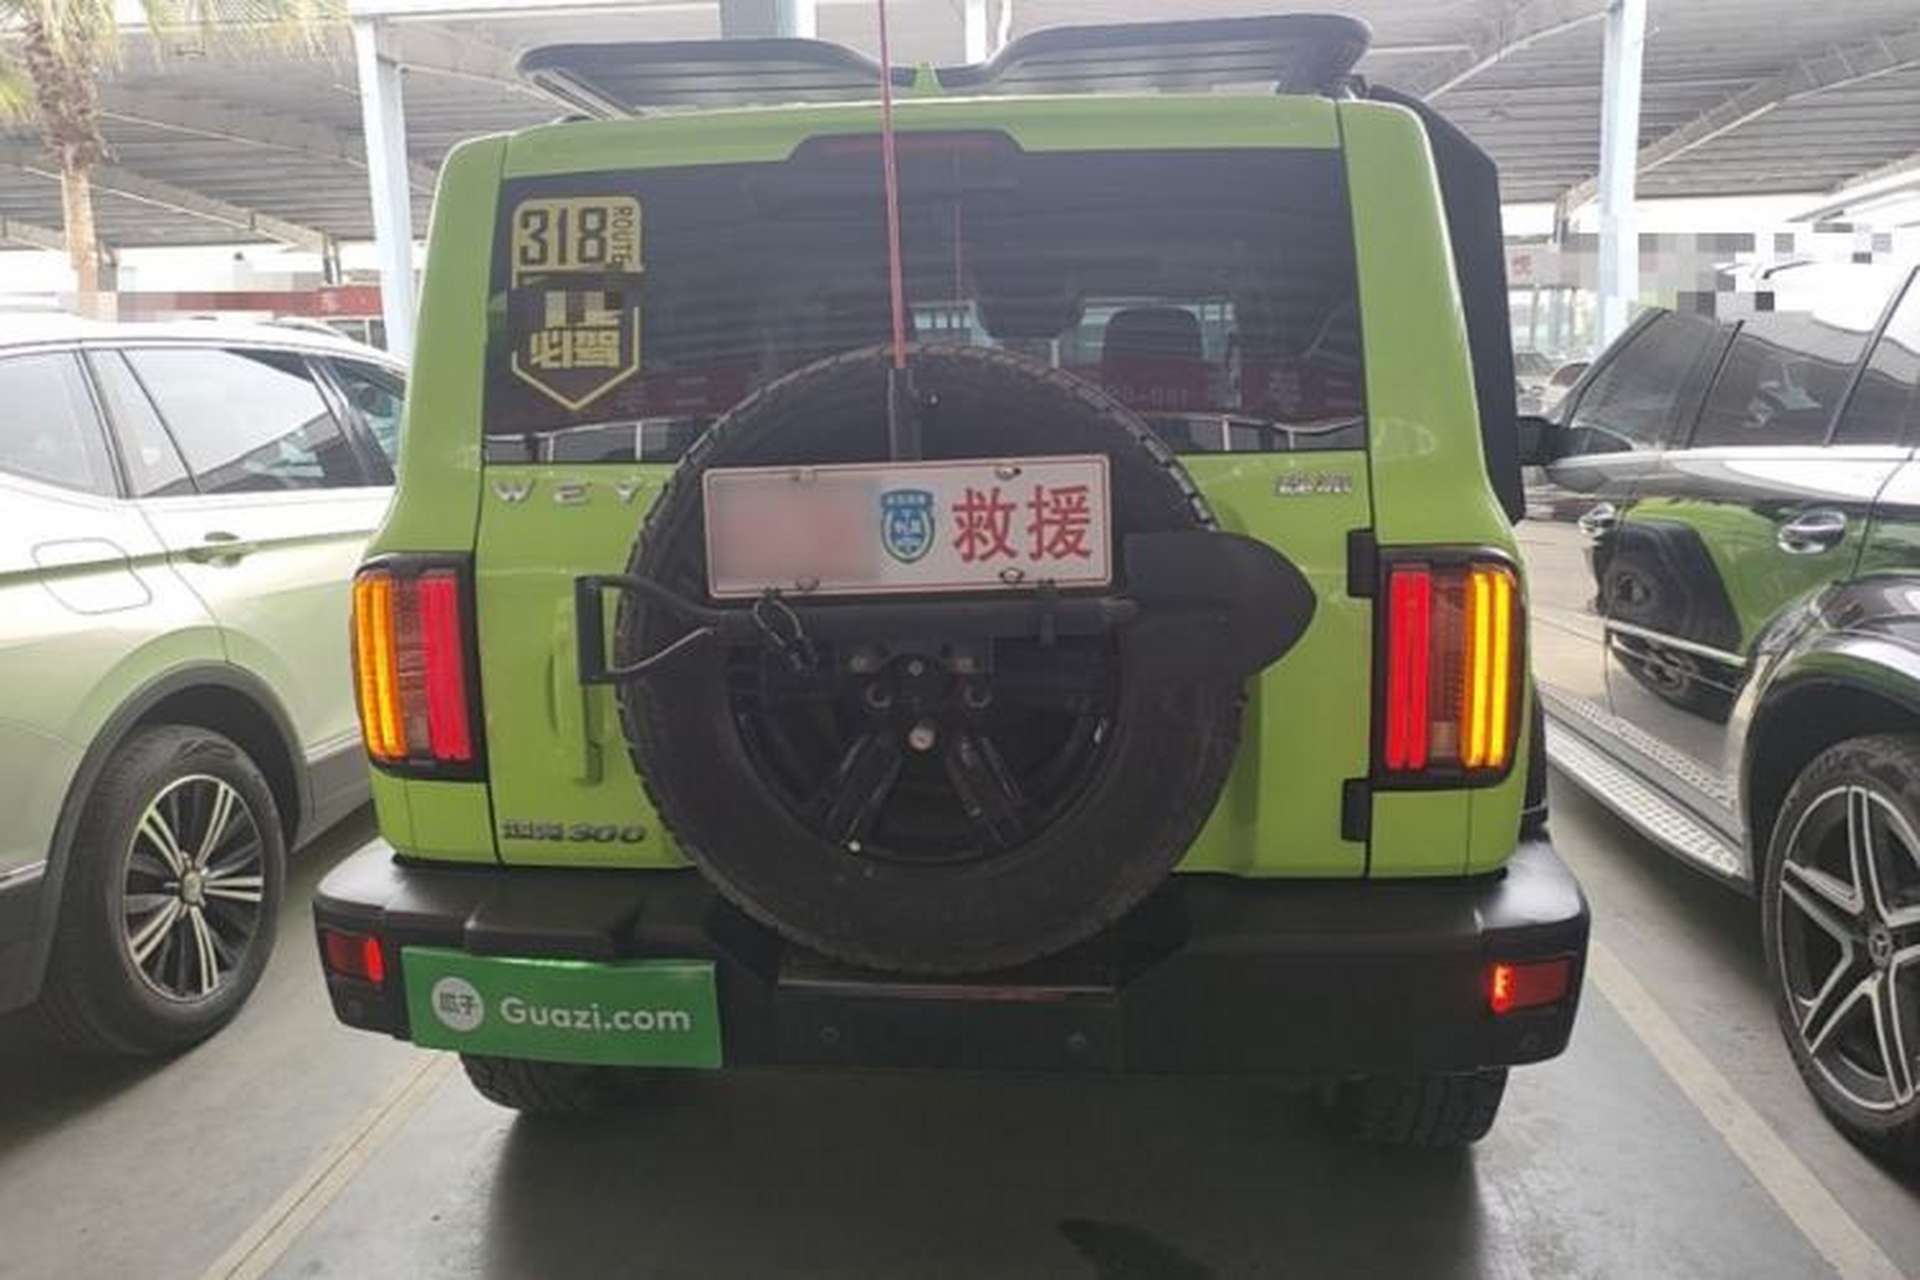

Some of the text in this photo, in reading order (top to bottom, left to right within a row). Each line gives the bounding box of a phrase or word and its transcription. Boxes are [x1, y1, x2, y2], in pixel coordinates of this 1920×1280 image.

[519, 206, 607, 267] 318
[491, 479, 640, 505] WEY
[951, 484, 1092, 563] 救援
[500, 996, 692, 1032] Guazi.com
